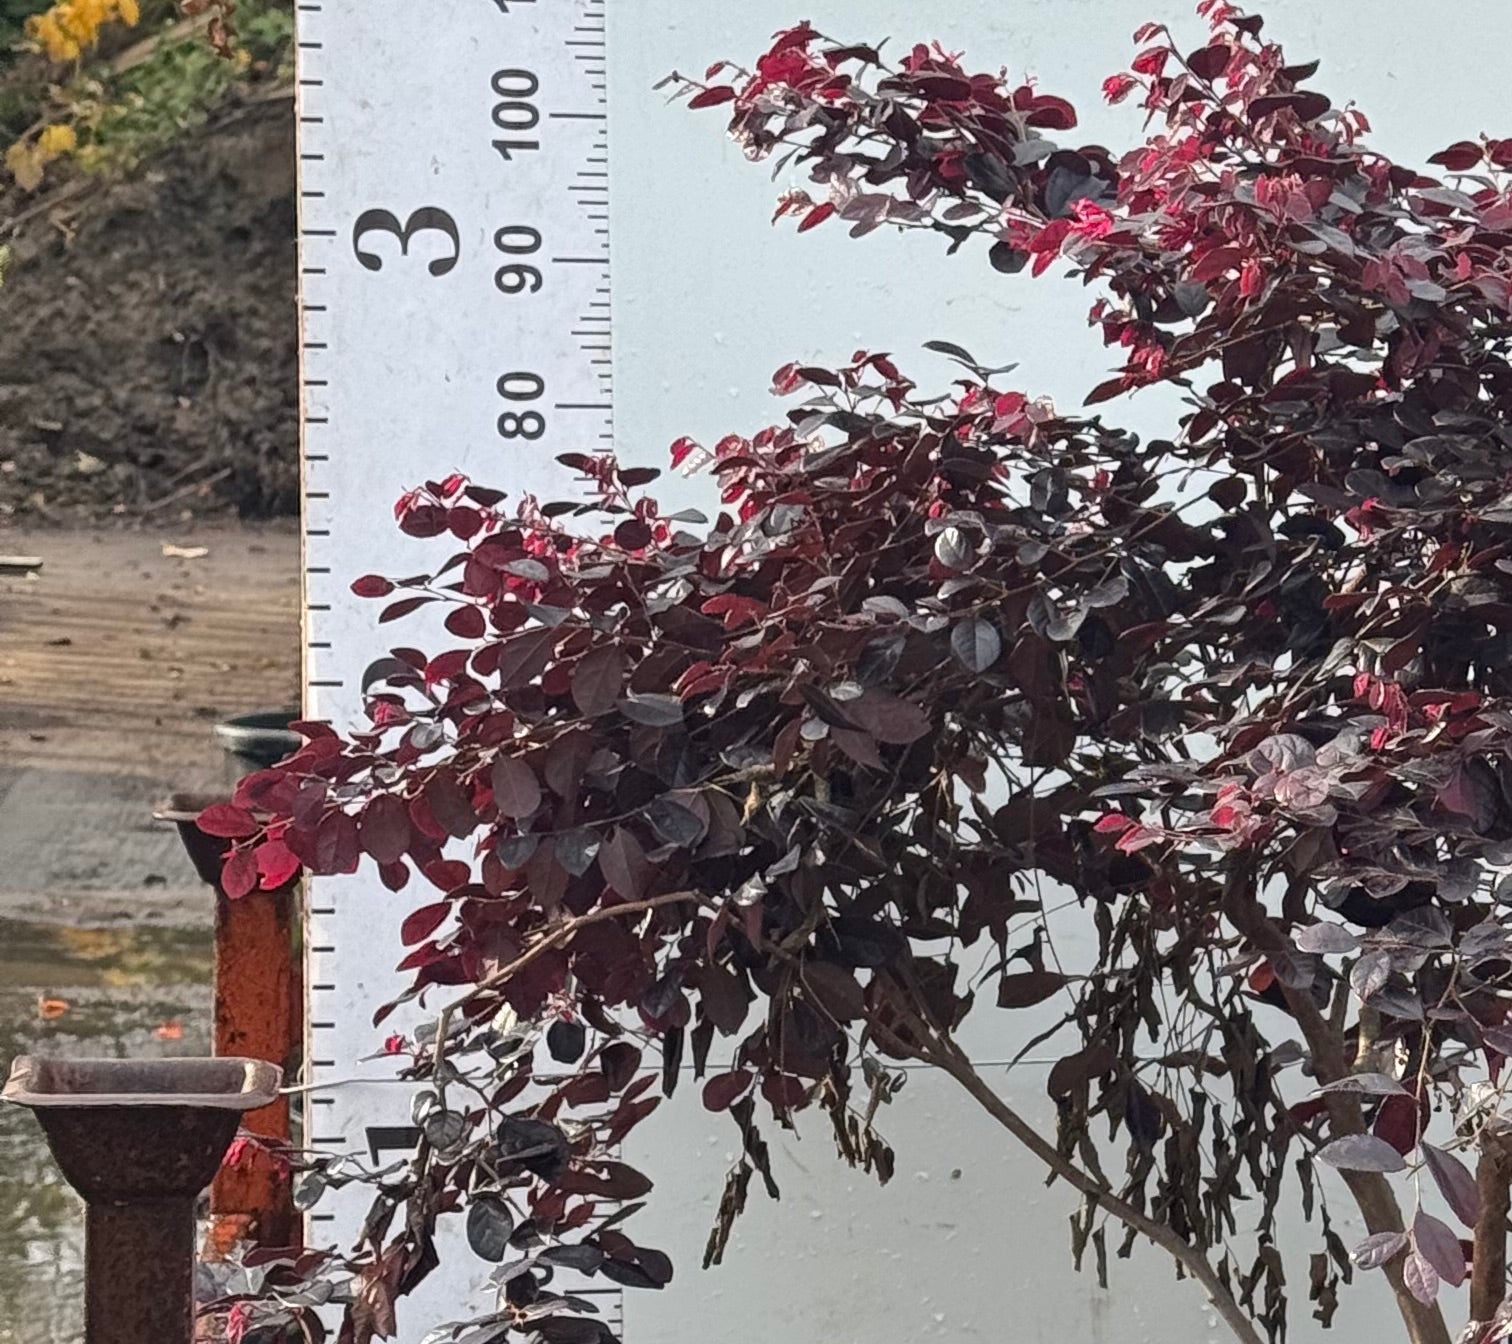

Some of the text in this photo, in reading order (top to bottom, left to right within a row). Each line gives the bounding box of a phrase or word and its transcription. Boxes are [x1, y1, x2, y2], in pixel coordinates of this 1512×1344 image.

[490, 68, 540, 161] 100
[352, 206, 460, 277] 3
[493, 225, 543, 295] 90
[496, 371, 546, 441] 80
